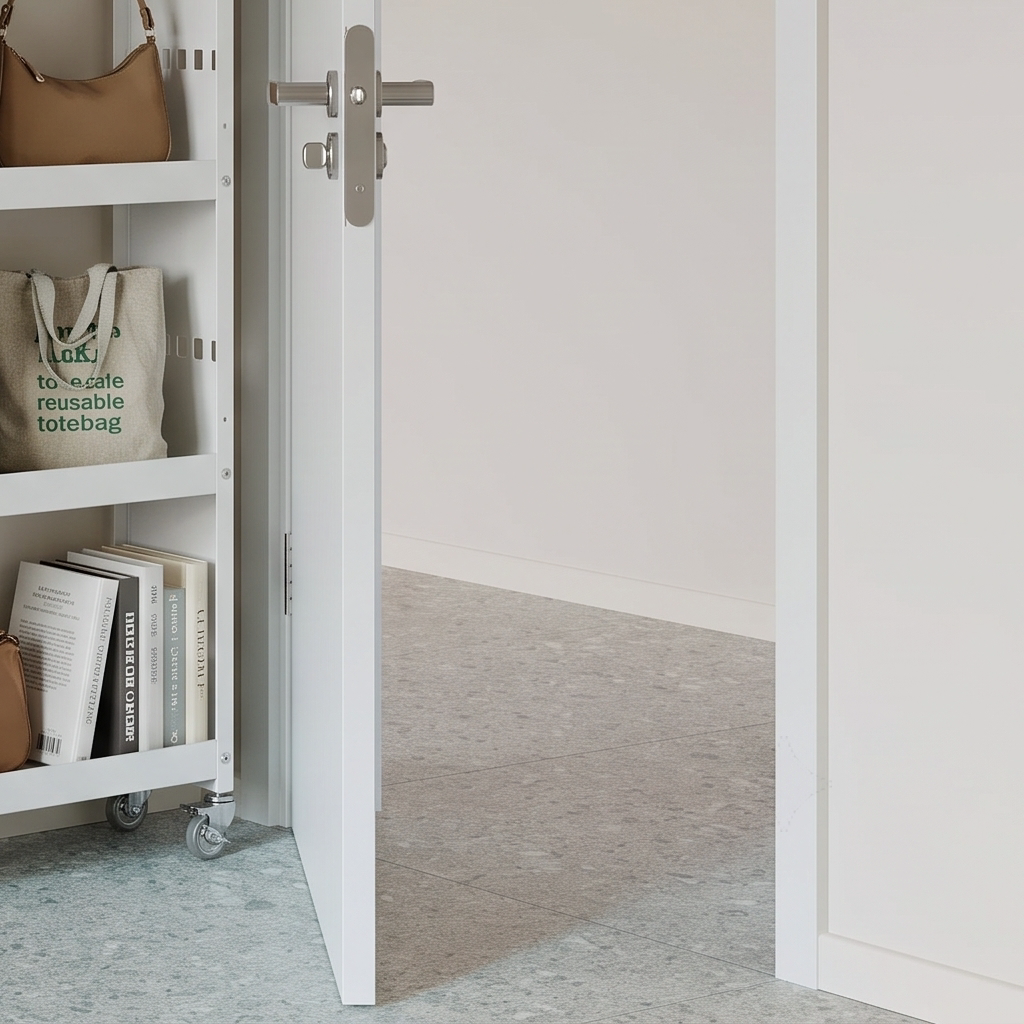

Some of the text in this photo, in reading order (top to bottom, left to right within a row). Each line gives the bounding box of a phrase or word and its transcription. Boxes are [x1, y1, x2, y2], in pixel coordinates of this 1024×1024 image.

[37, 375, 58, 389] to
[37, 393, 125, 411] reusable
[37, 415, 122, 434] totebag
